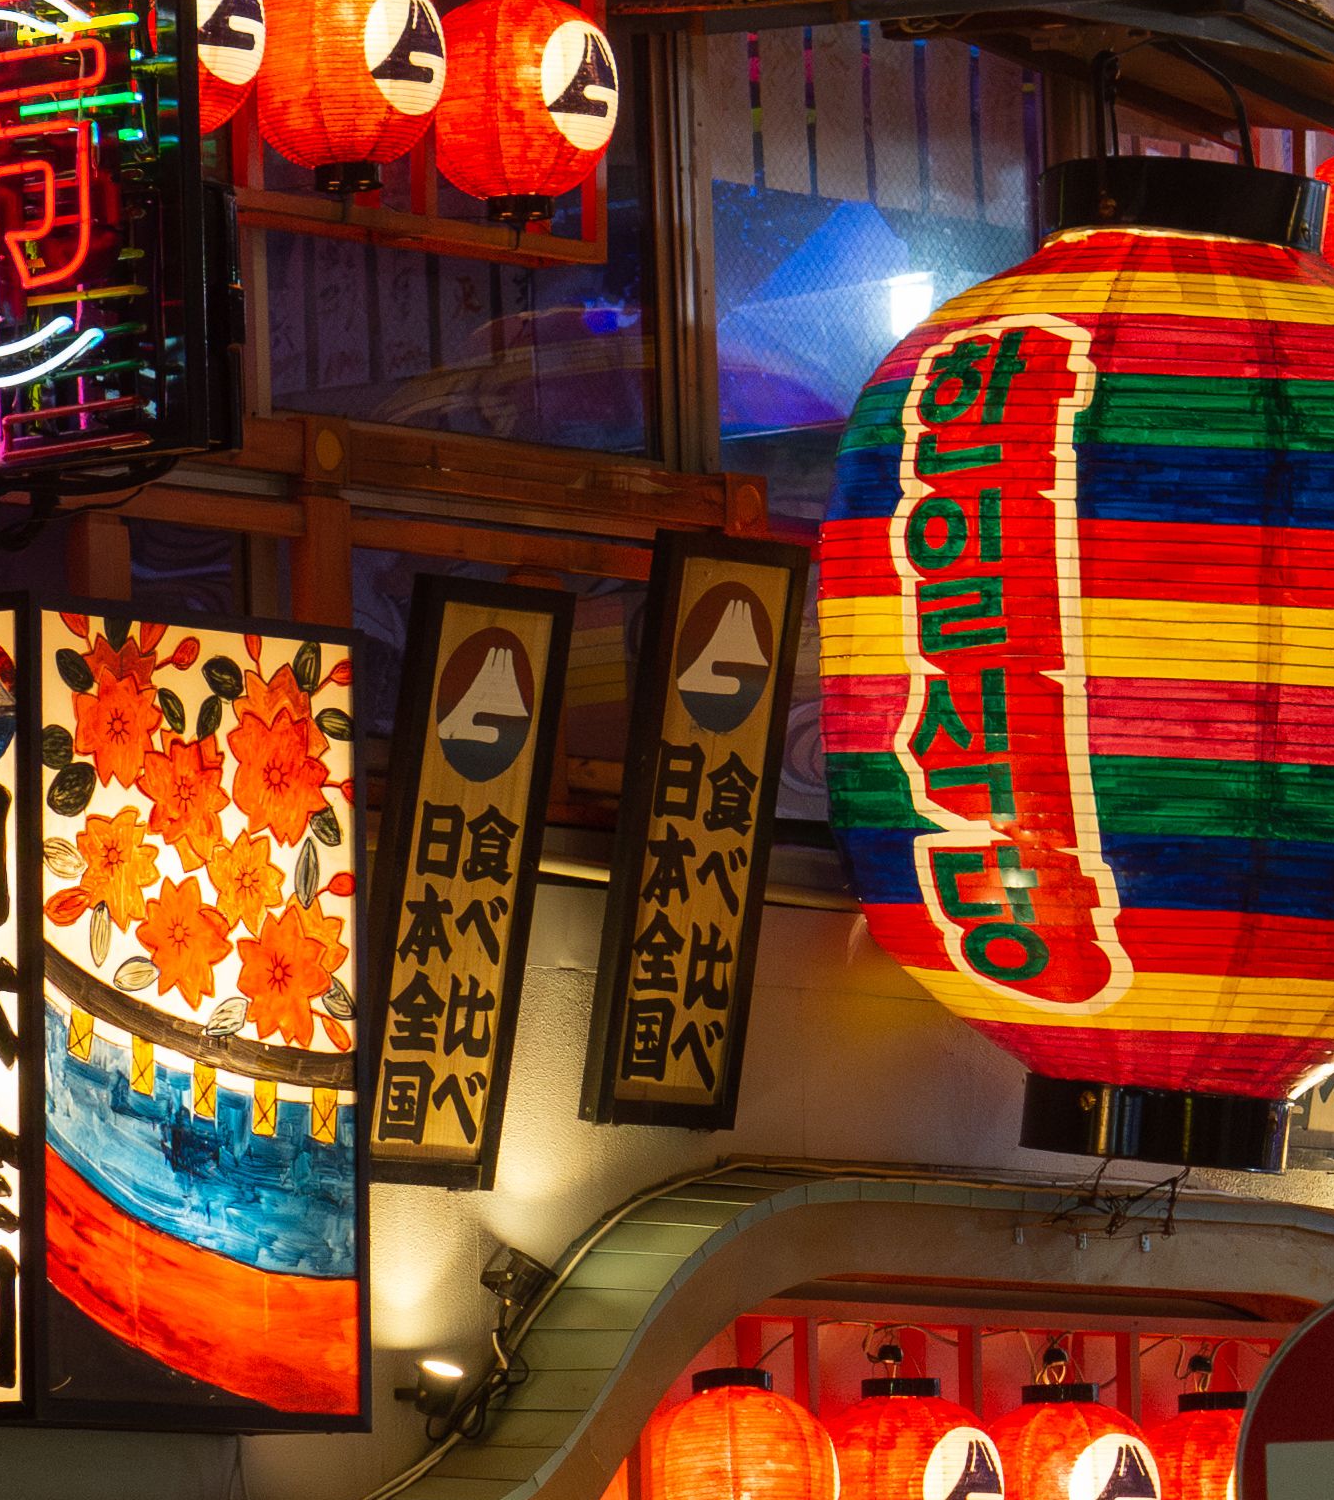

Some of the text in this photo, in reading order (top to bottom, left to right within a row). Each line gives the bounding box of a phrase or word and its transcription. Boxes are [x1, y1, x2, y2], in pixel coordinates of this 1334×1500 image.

[905, 330, 1051, 985] 한일식당
[377, 801, 464, 1145] 日本全国
[431, 805, 521, 1146] 食べ比べ
[621, 740, 707, 1083] 日本全国
[671, 753, 759, 1093] 食べ比べ
